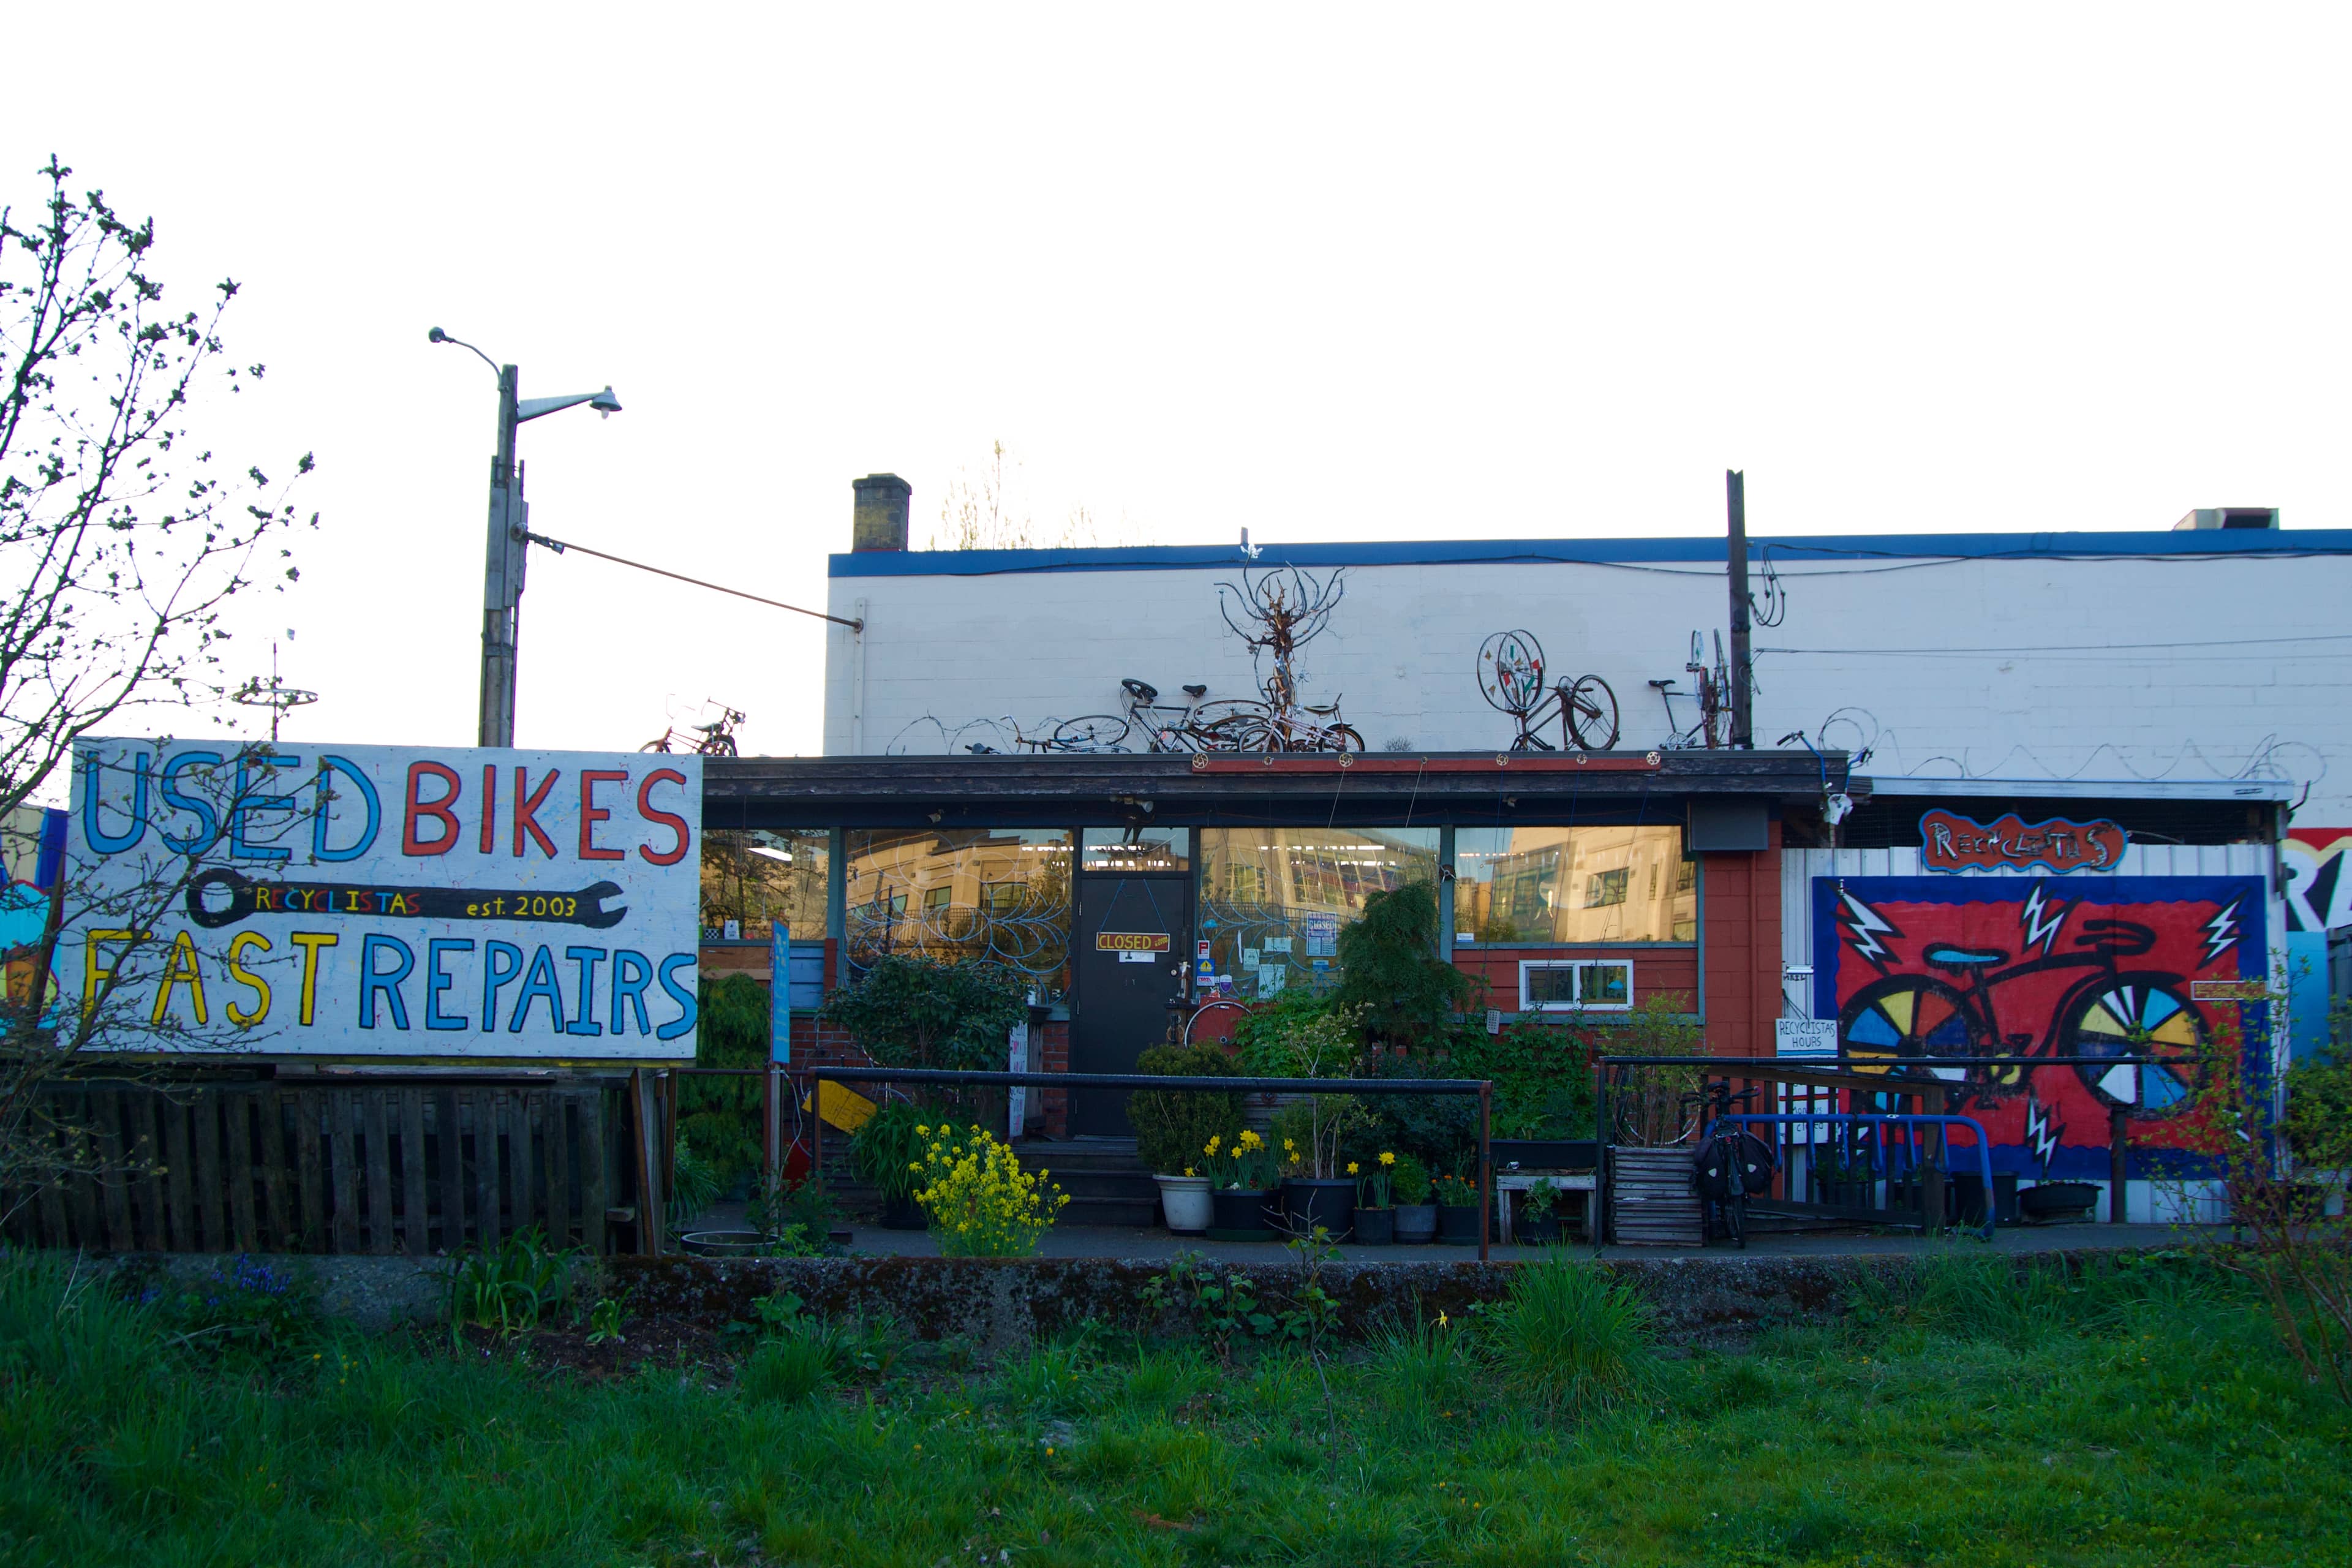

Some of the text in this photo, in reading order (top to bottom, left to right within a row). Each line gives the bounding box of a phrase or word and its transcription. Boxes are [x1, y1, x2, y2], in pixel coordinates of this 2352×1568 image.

[83, 751, 690, 866] USED BIKES
[255, 887, 577, 916] RECYCLISTAS est. 2003
[1308, 921, 1334, 930] CLOSED
[1099, 935, 1152, 949] CLOSED
[81, 929, 339, 1027] FAST
[359, 933, 698, 1040] REPAIRS
[1779, 1021, 1836, 1038] RECYCLISTAS
[1792, 1036, 1822, 1047] HOURS
